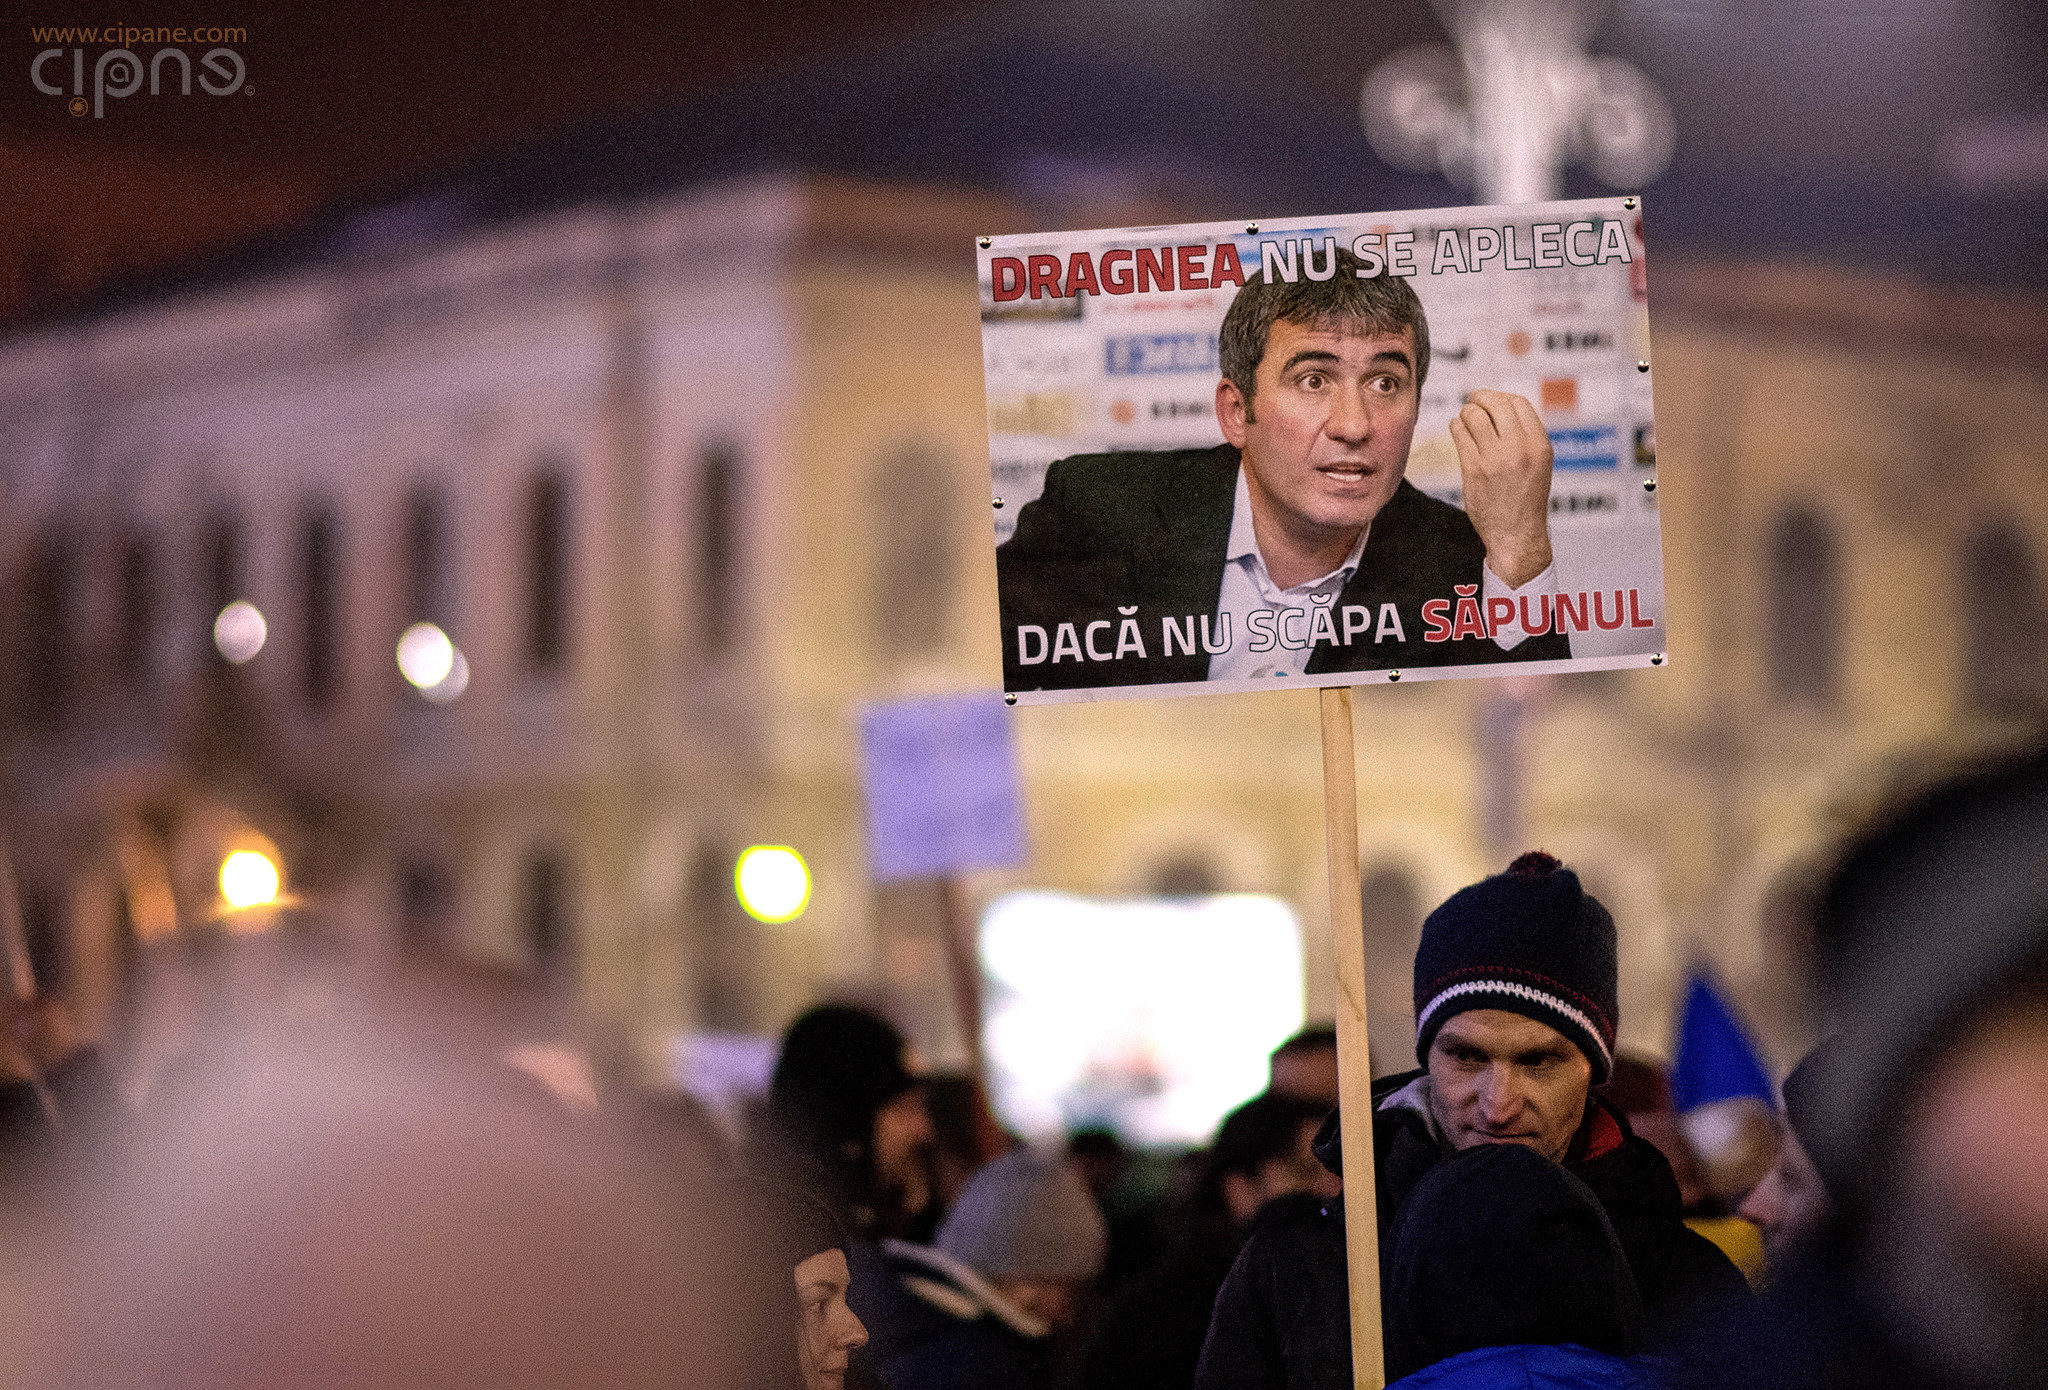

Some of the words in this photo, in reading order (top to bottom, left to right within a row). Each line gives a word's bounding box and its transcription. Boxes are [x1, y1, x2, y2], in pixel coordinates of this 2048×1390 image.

[991, 243, 1245, 303] DRAGNEA
[1260, 236, 1337, 285] NU
[1352, 232, 1417, 279] SE
[1431, 219, 1633, 275] APLECA
[1017, 605, 1148, 666] DACĂ
[1161, 612, 1233, 658] NU
[1246, 593, 1407, 653] SCĂPA
[1421, 584, 1655, 643] SĂPUNUL
